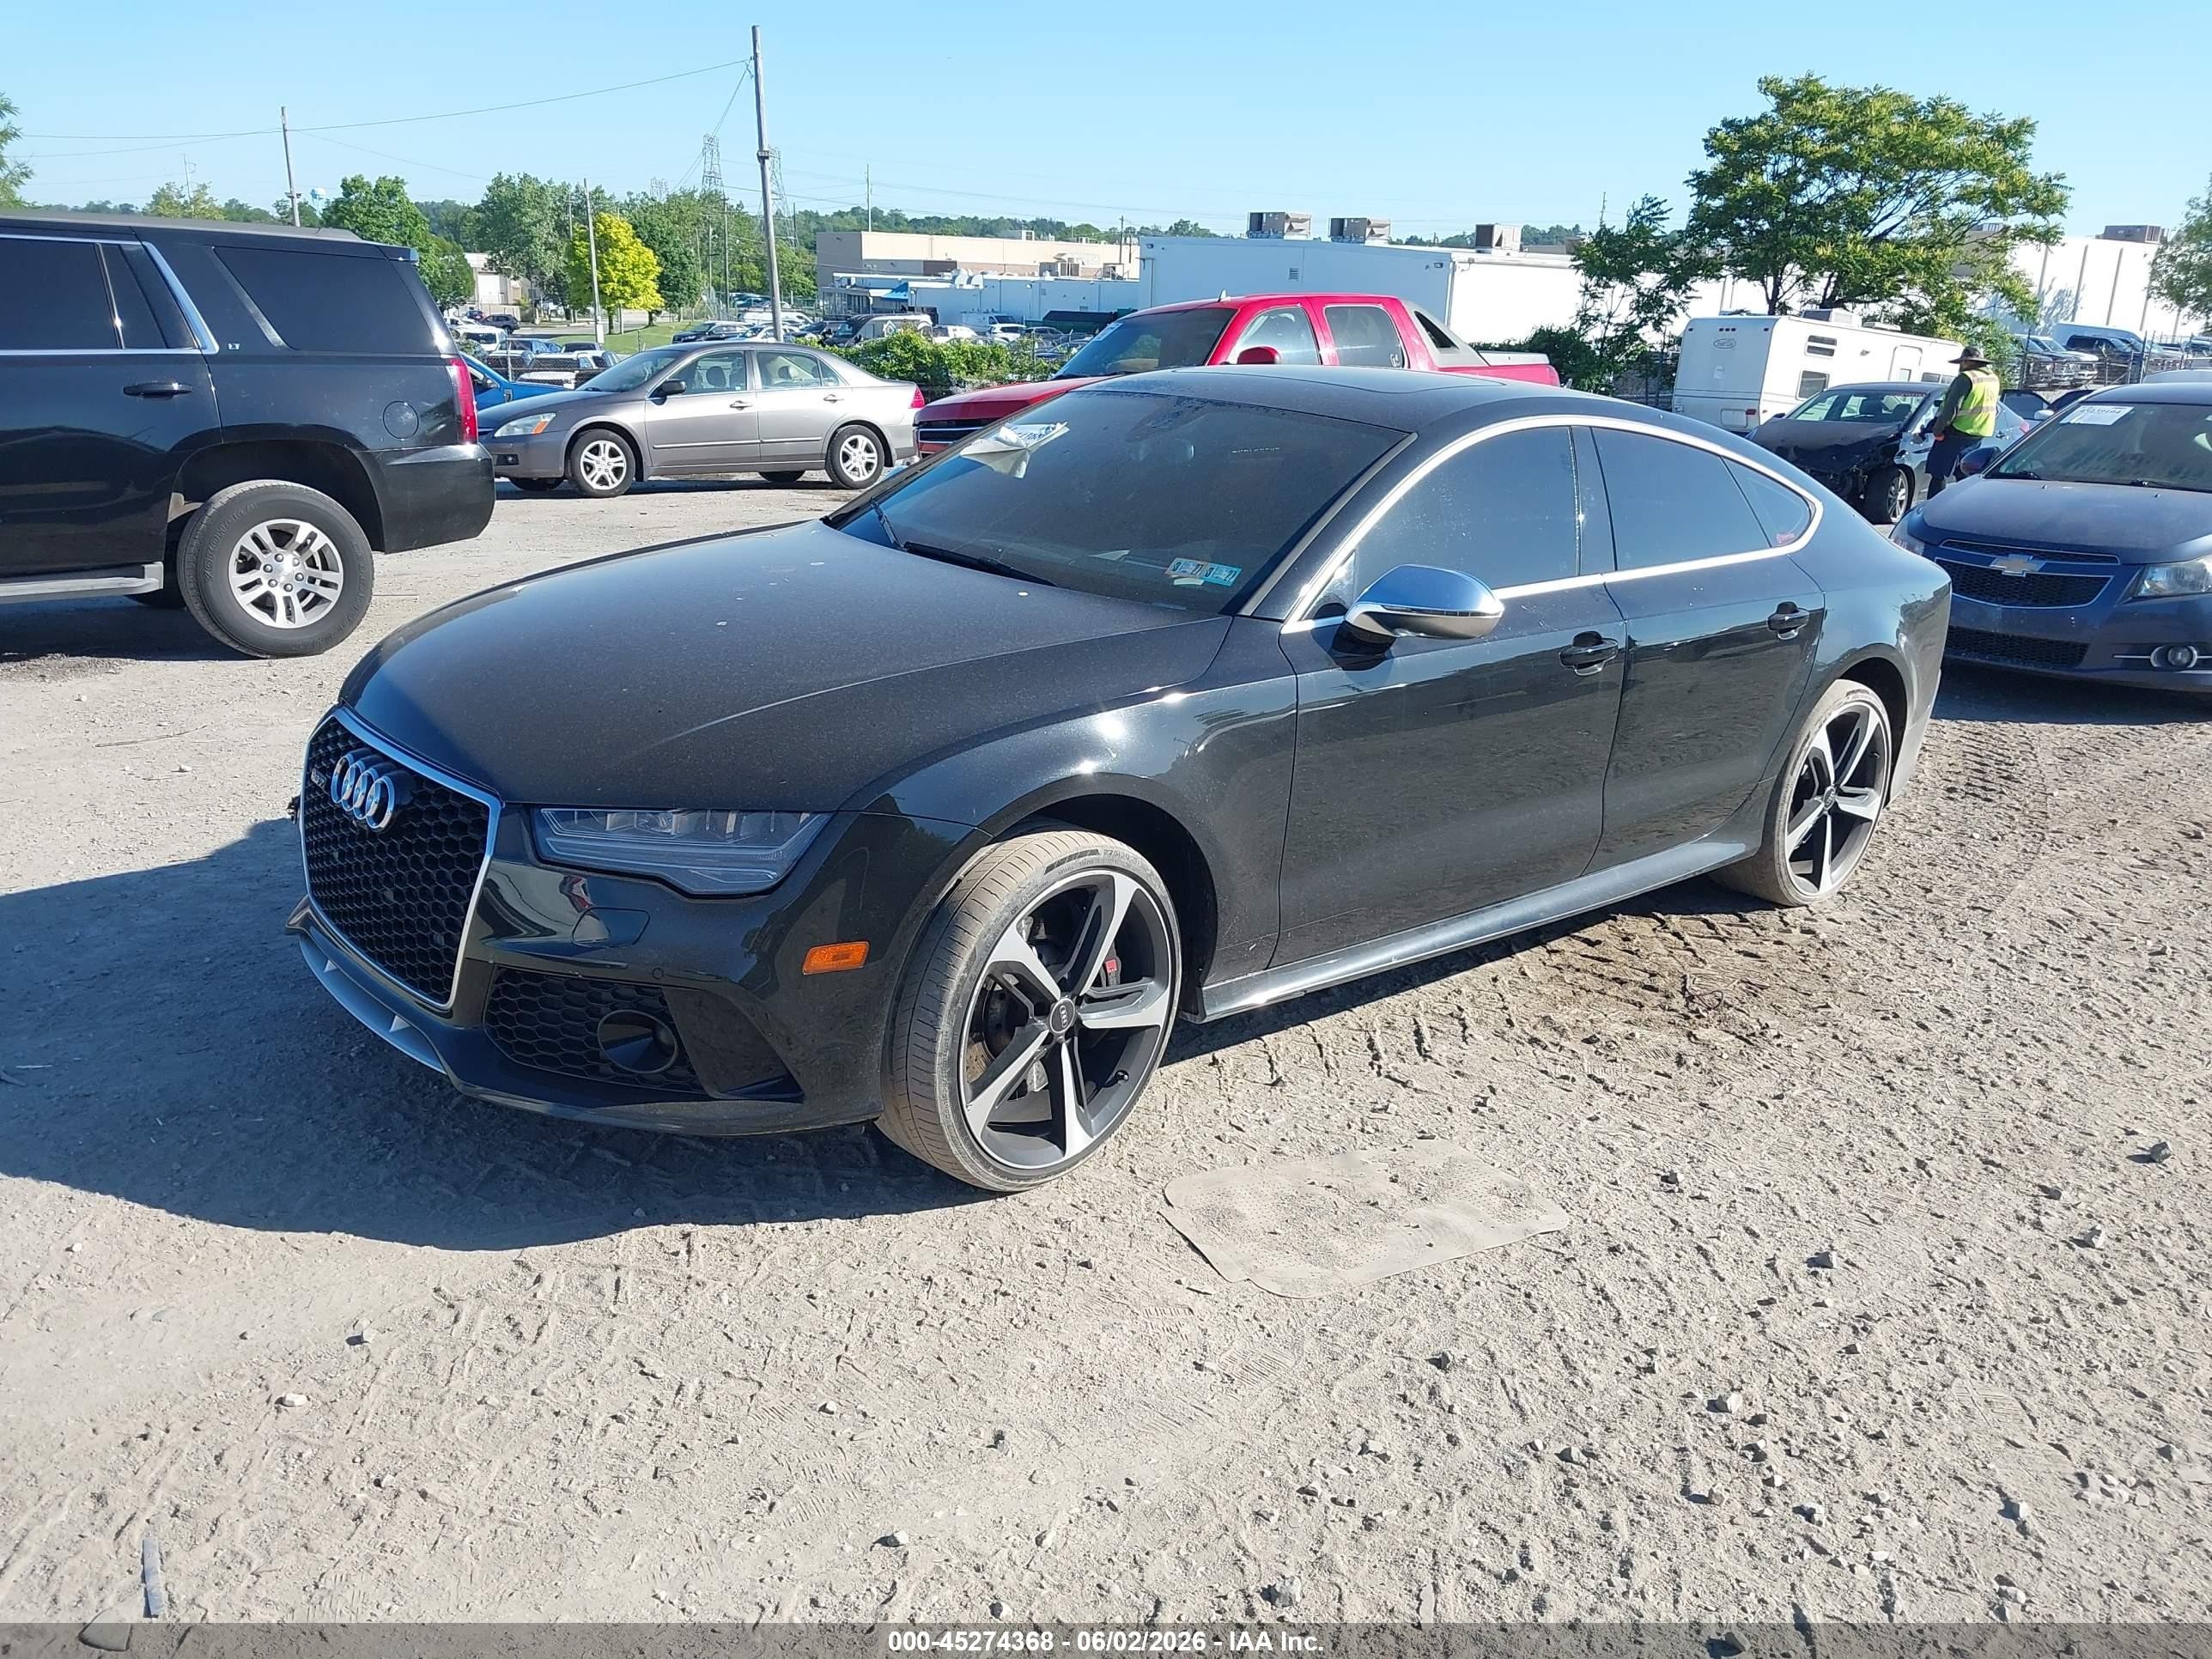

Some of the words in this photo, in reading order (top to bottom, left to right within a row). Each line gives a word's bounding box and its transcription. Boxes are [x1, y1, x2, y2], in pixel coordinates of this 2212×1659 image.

[1172, 562, 1182, 572] 3
[1190, 562, 1204, 576] 27
[1224, 569, 1237, 582] 27
